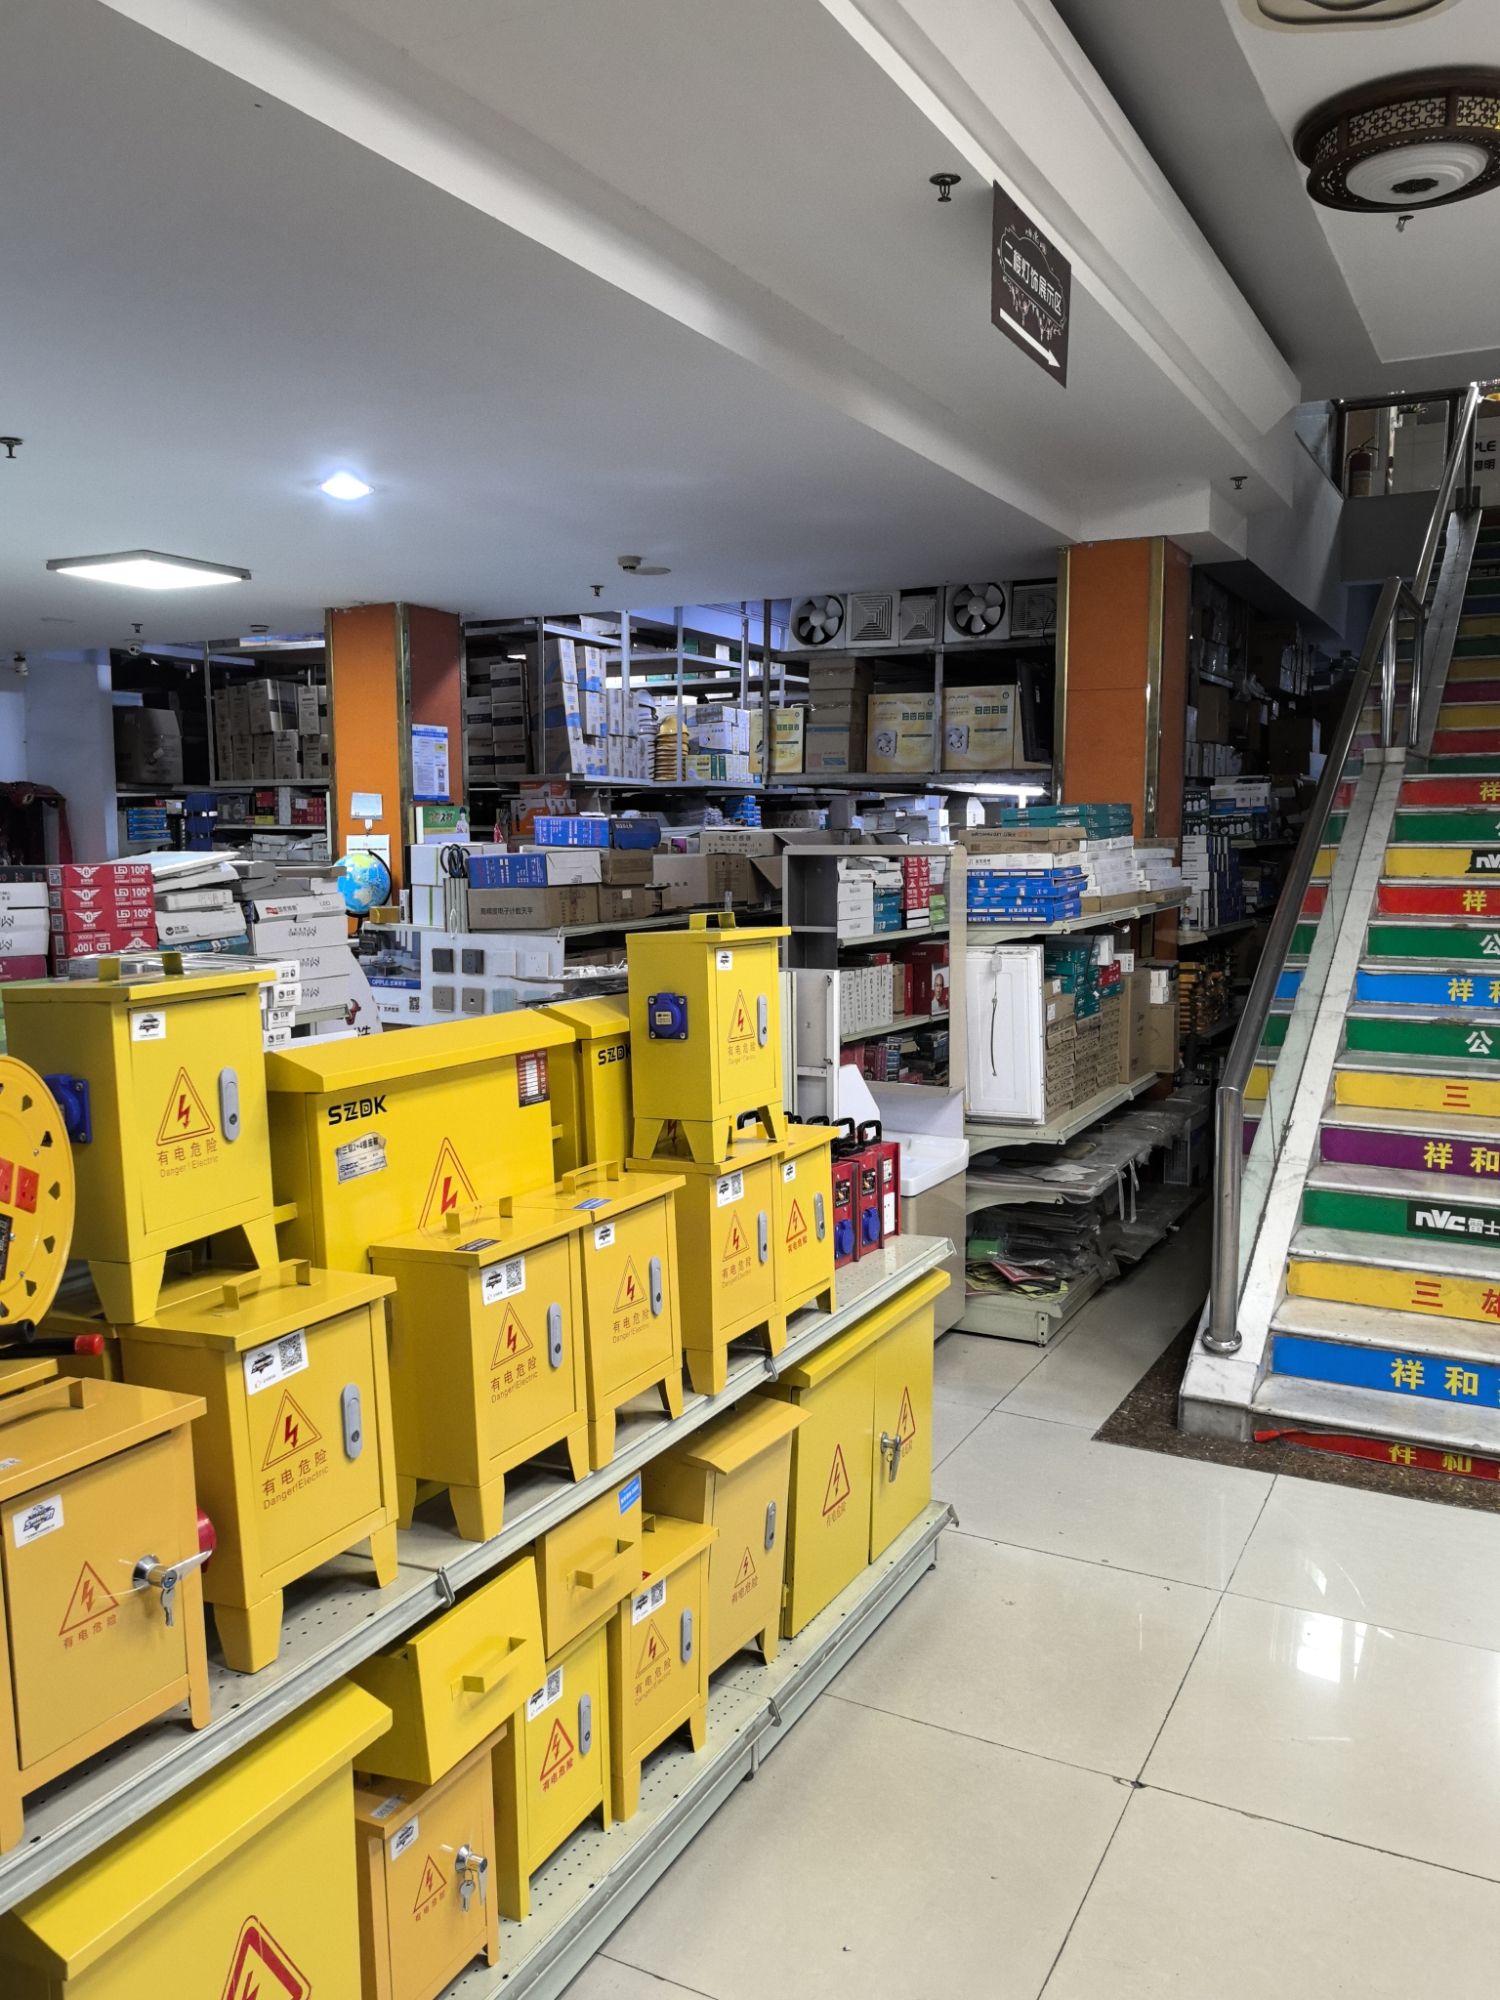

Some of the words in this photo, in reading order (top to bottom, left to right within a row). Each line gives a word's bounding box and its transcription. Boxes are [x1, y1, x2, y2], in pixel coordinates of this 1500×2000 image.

[114, 865, 128, 875] LED
[114, 887, 129, 897] LED
[1462, 889, 1487, 912] 祥
[116, 909, 130, 919] LED
[1465, 1031, 1494, 1055] 公
[328, 1094, 388, 1126] SZDK
[1442, 1085, 1471, 1108] 三
[157, 1138, 218, 1167] 有电危险
[1424, 1141, 1500, 1174] 祥和
[721, 1256, 752, 1280] 有电危险
[612, 1308, 650, 1333] 有电危险
[490, 1355, 538, 1392] 有电危险
[1390, 1357, 1479, 1396] 祥和
[262, 1449, 328, 1496] 有电危险
[731, 1575, 759, 1605] 有电危险
[63, 1614, 118, 1649] 有电危险
[634, 1656, 672, 1697] 有电危险
[542, 1757, 574, 1793] 有电危险
